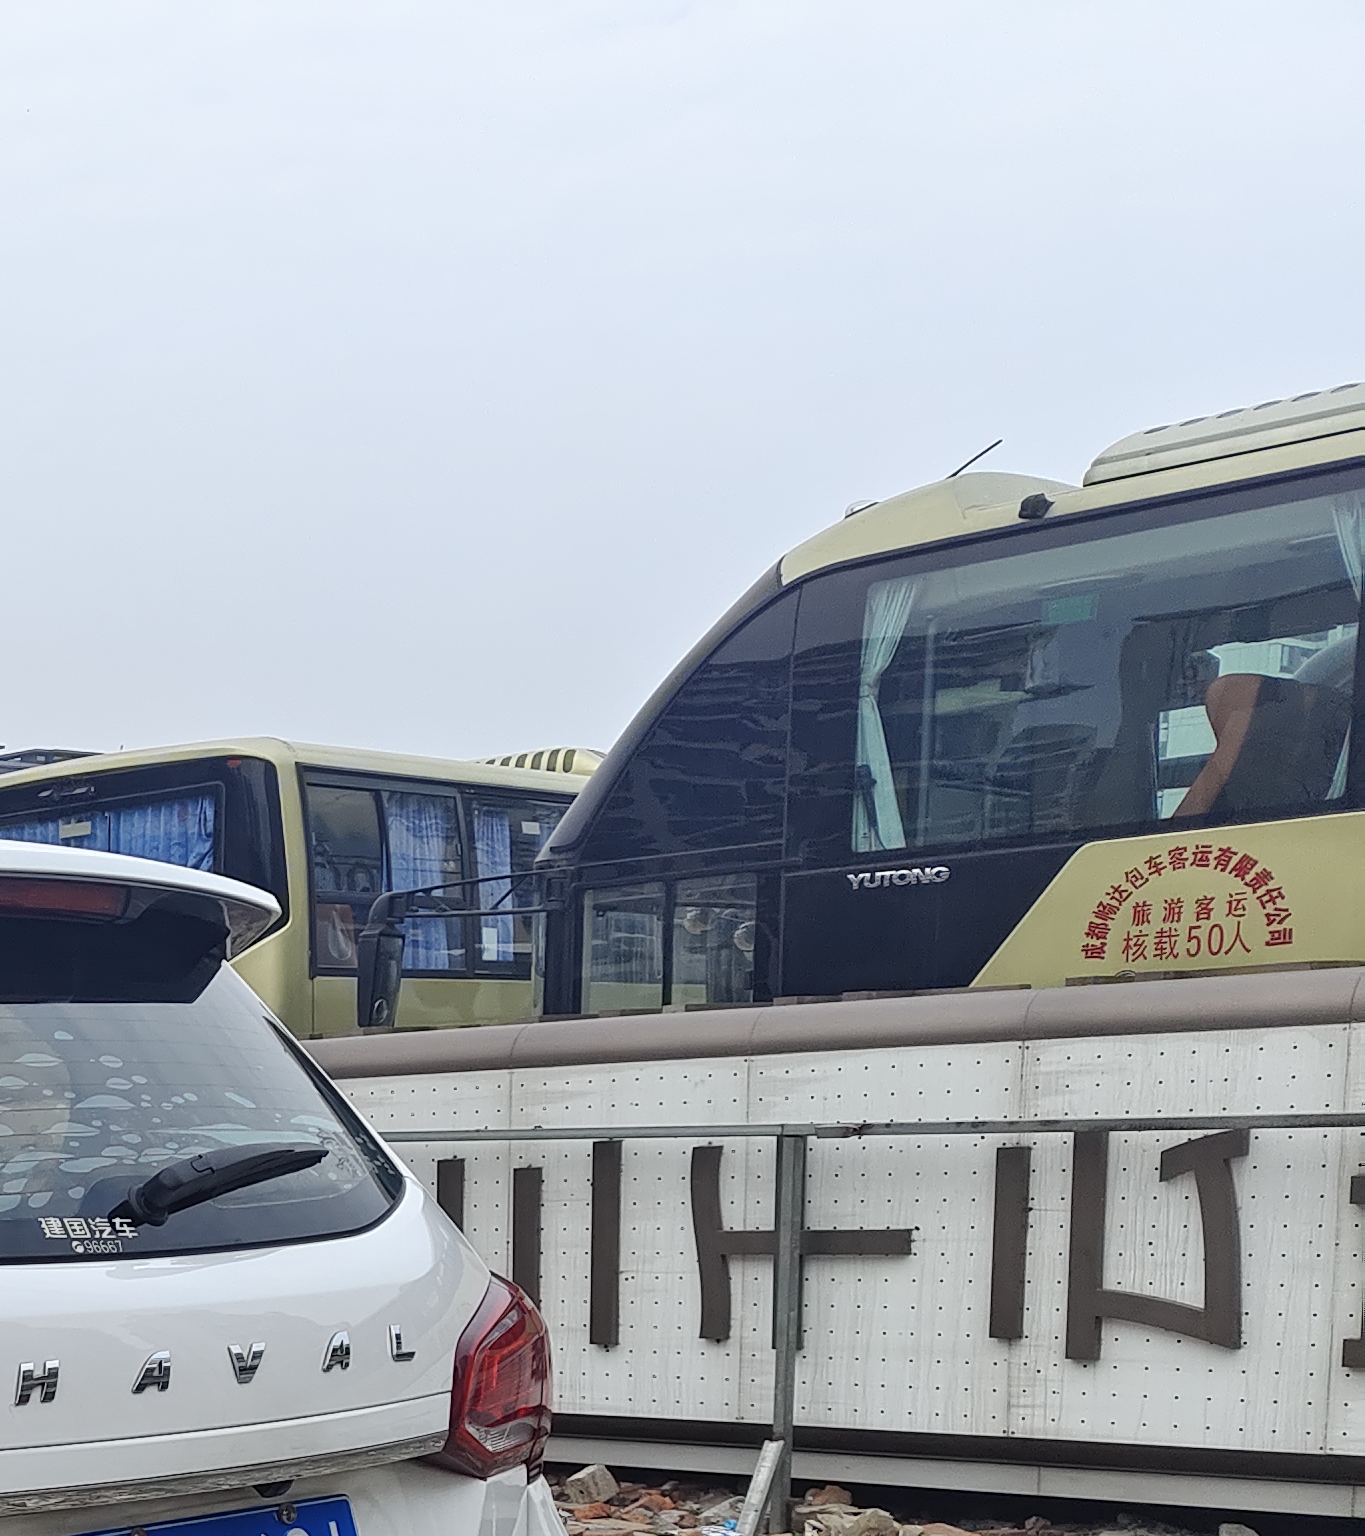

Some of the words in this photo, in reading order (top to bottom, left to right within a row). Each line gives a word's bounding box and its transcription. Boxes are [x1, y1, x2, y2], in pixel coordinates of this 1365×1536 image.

[847, 866, 950, 890] YUTONG
[1081, 844, 1293, 960] 成都畅达包车客运有限责任公司
[1131, 891, 1248, 927] 旅游客运
[1122, 920, 1251, 963] 核载50人
[38, 1216, 139, 1239] 建国汽车
[84, 1240, 124, 1254] 96667
[13, 1323, 417, 1407] HAVAL
